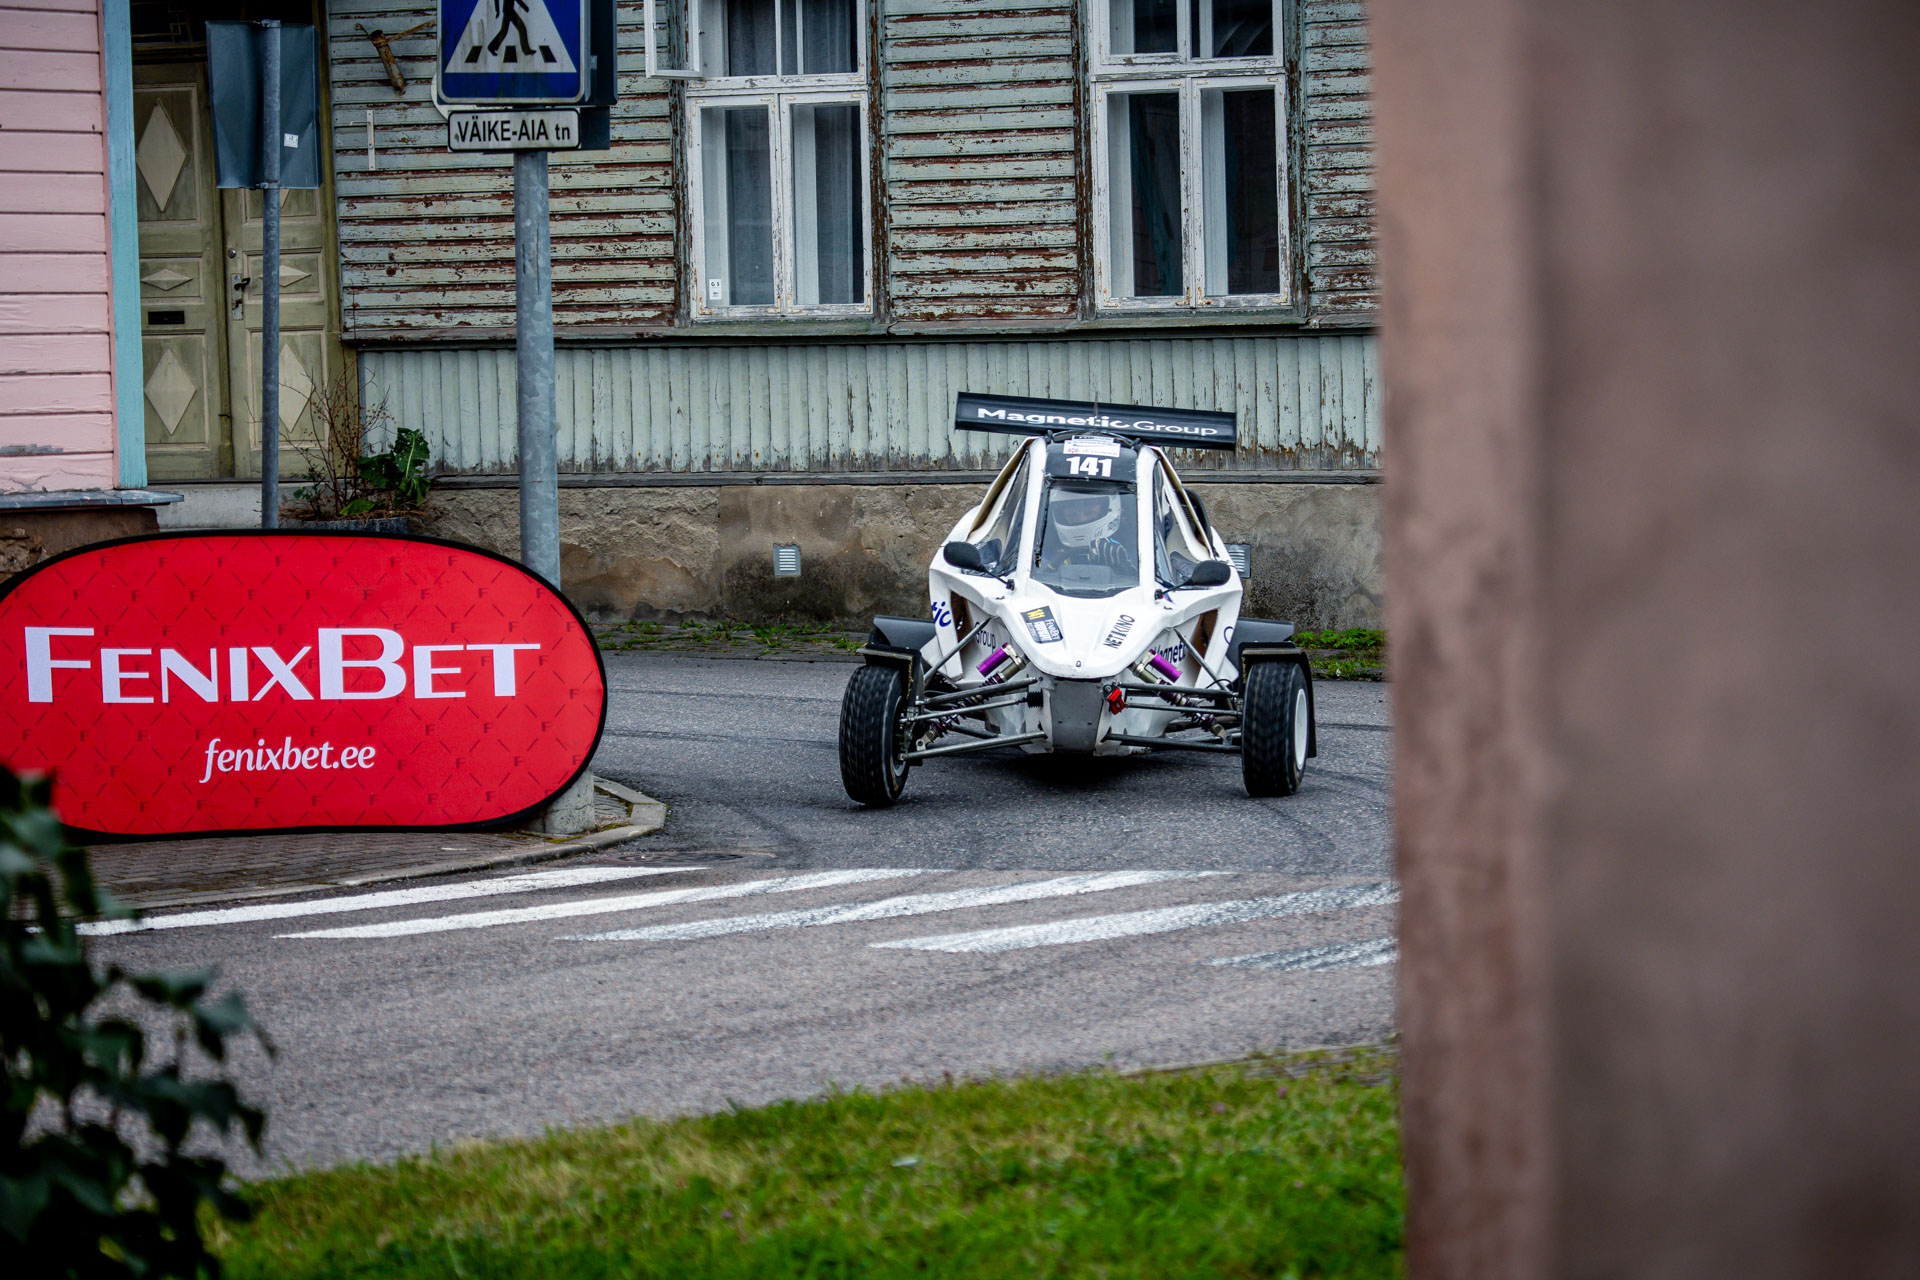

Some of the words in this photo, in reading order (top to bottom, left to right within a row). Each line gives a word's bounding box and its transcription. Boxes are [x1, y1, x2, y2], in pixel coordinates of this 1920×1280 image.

[457, 115, 549, 142] VÄIKE-AIA
[554, 123, 570, 141] tn
[977, 407, 1130, 429] Magnetic
[1133, 420, 1218, 437] Group
[1066, 456, 1112, 477] 141
[199, 736, 376, 783] fenixbet.ee
